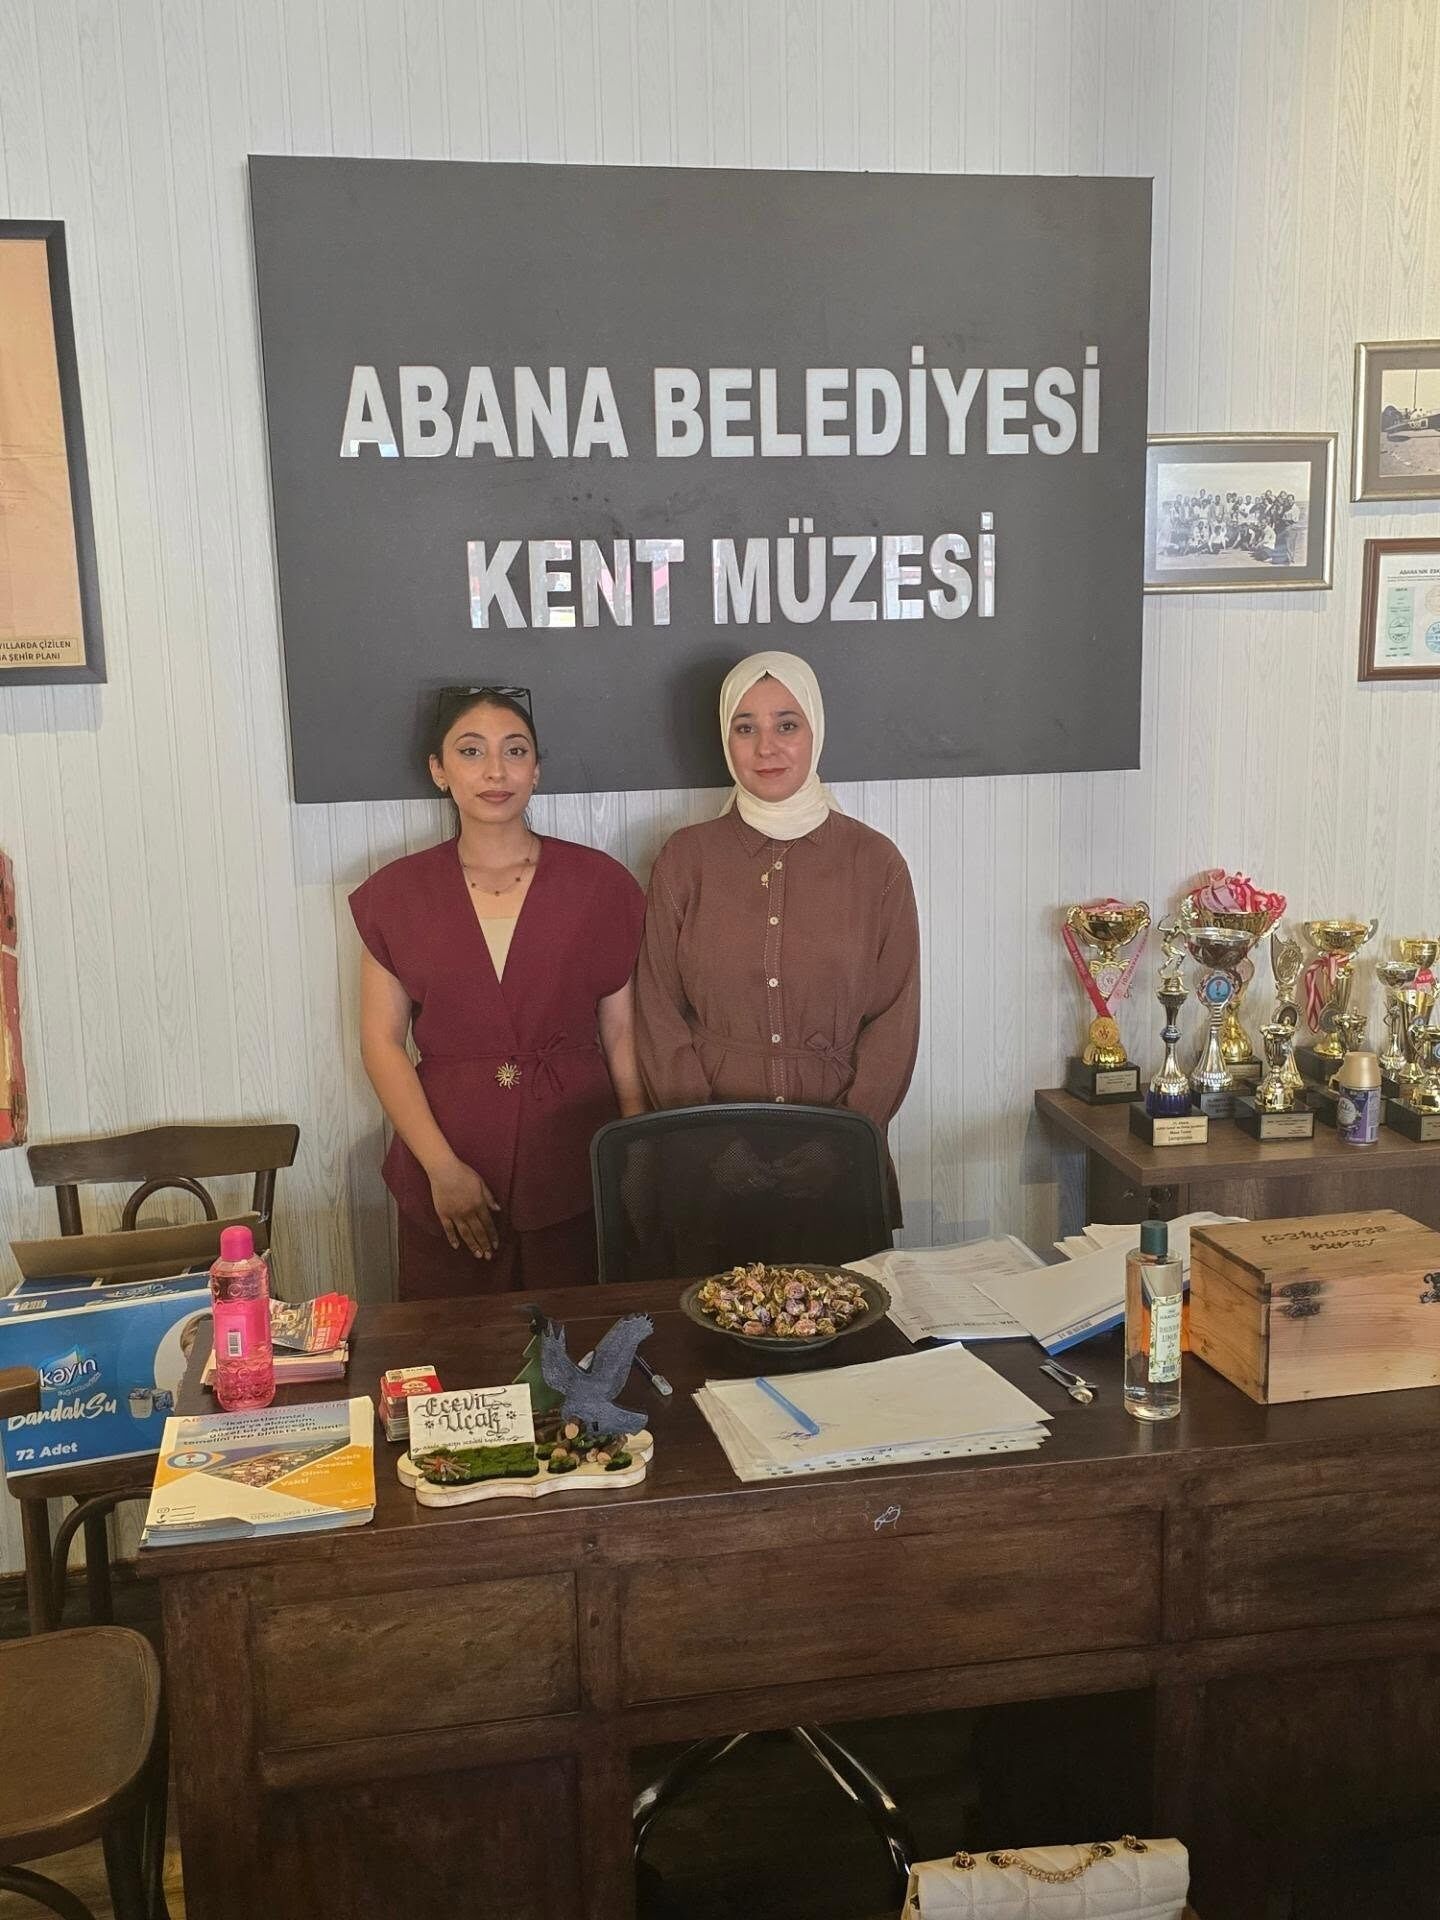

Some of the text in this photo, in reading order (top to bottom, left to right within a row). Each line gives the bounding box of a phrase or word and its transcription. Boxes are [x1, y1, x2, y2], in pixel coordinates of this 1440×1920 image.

[340, 345, 1100, 458] ABANA BELEDİYESİ
[467, 511, 995, 628] KENT MÜZESİ
[39, 640, 71, 650] ÇİZİLEN
[9, 652, 34, 662] ŞEHİR
[36, 652, 60, 660] PLANI
[16, 1442, 78, 1461] 72 Adet
